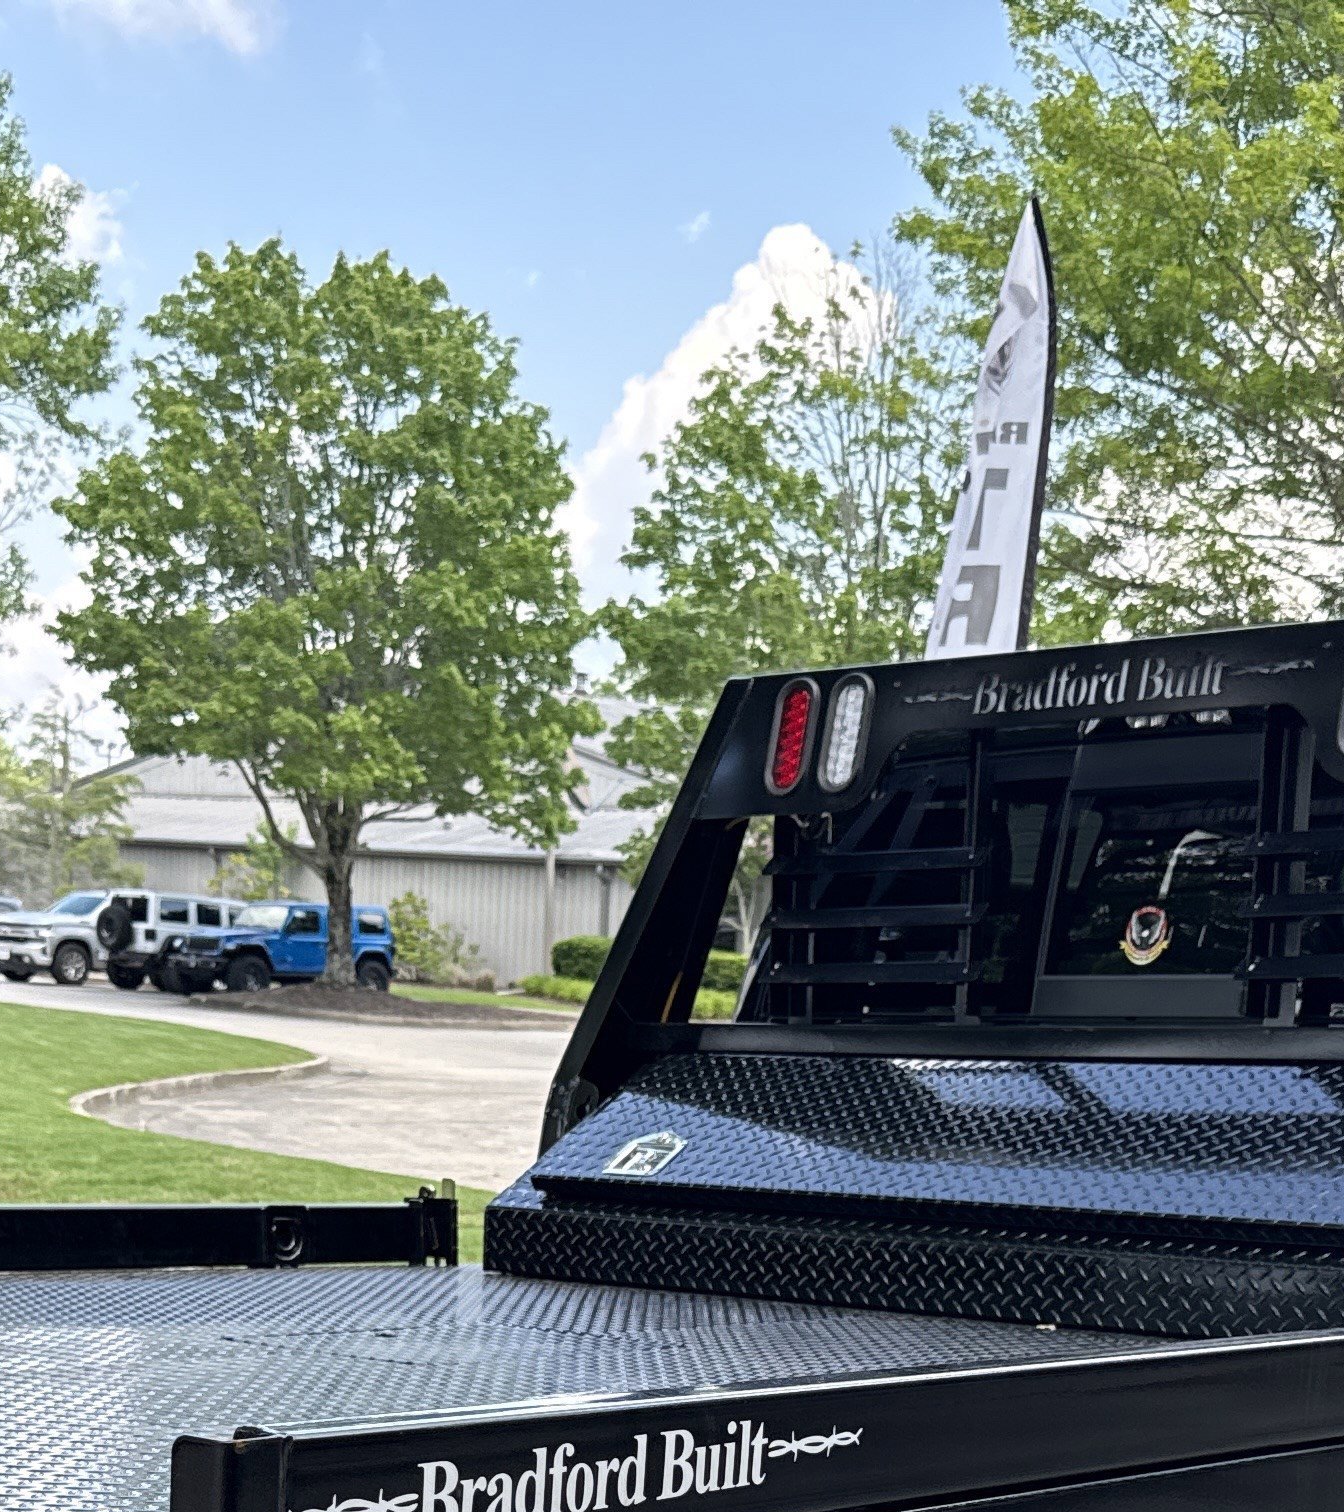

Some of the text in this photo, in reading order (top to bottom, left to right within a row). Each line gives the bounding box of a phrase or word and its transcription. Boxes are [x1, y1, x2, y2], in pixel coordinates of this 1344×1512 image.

[971, 657, 1226, 715] Bradford Built
[656, 1419, 769, 1501] Built
